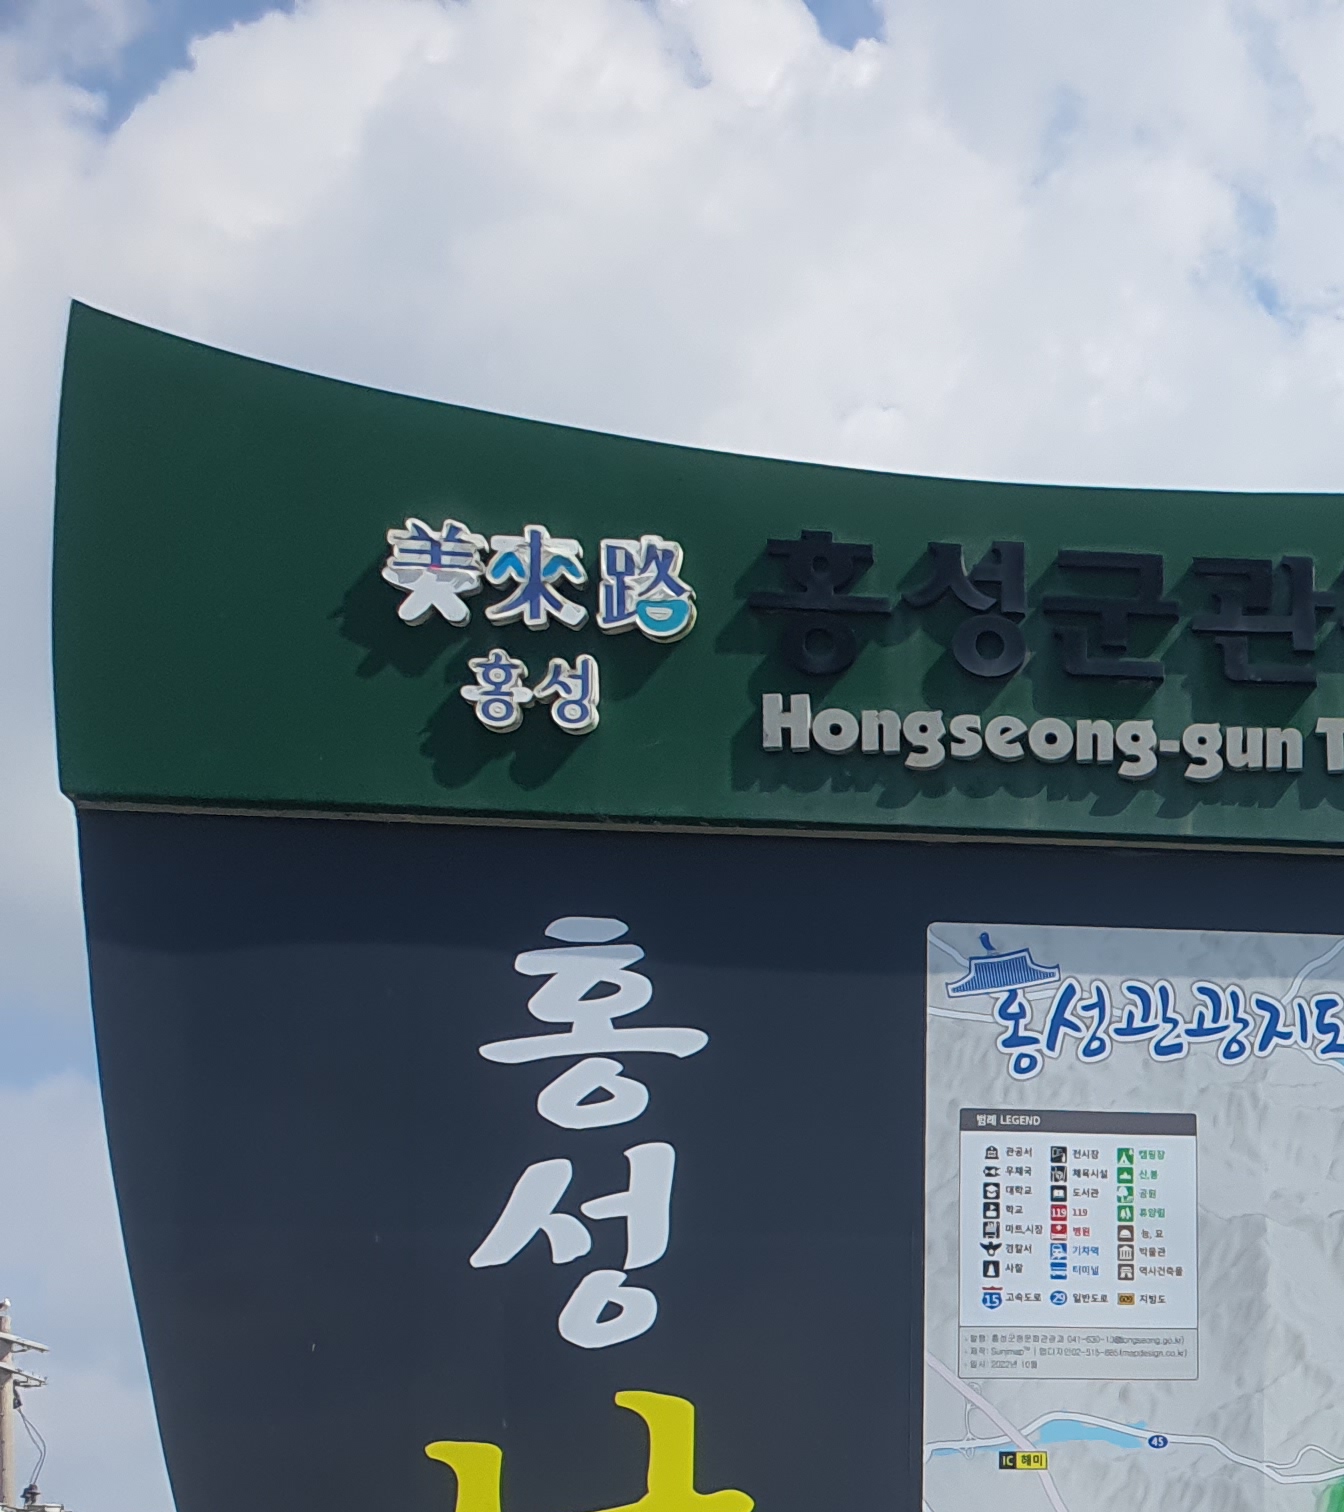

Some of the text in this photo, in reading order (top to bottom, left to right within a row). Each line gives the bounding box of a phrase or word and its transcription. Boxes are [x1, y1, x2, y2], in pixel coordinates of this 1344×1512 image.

[386, 519, 696, 640] 美來路
[462, 649, 600, 734] 홍성
[762, 693, 1303, 778] Hongseong-gun
[977, 1115, 1040, 1125] 범례 LEGEND
[469, 916, 709, 1348] 홍성
[1006, 1147, 1032, 1157] 관공서
[1073, 1150, 1099, 1159] 전시장
[1006, 1186, 1032, 1195] 대학교
[1073, 1189, 1099, 1198] 도서관
[1006, 1205, 1023, 1214] 학교
[1073, 1227, 1090, 1236] 병원
[1073, 1246, 1099, 1256] 기차역
[985, 1294, 999, 1306] 15
[1052, 1293, 1065, 1303] 29
[1150, 1436, 1165, 1448] 45
[1002, 1453, 1043, 1468] IC 해미
